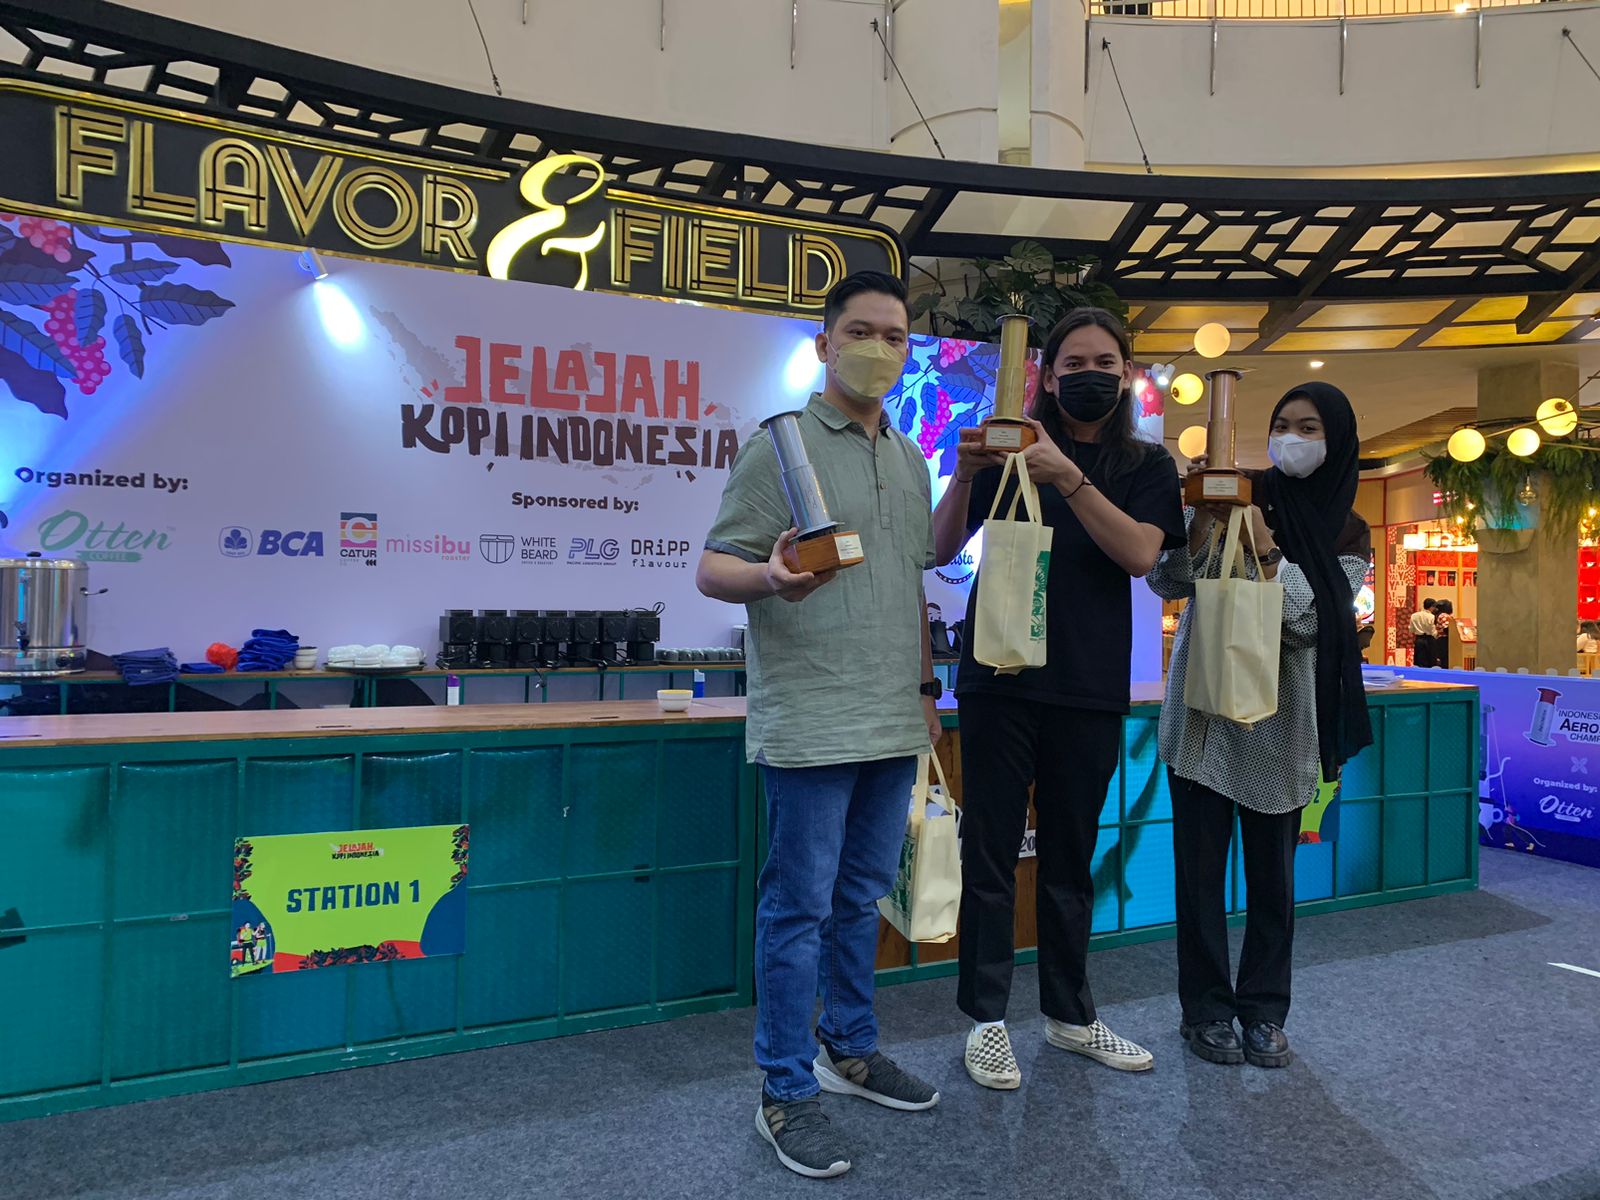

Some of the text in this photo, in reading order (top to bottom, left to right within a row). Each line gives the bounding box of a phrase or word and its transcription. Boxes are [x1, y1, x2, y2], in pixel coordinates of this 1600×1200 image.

[55, 105, 847, 308] FLAVOR & FIELD
[444, 335, 700, 420] JELAJAH
[401, 404, 739, 470] KOPI INDONESIA
[15, 467, 189, 493] Organized by:
[512, 492, 639, 513] Sponsored by:
[38, 509, 172, 551] Otten
[257, 529, 324, 557] BCA
[340, 549, 377, 558] CATUR
[386, 534, 471, 554] missibu
[521, 536, 557, 548] WHITE
[568, 538, 620, 560] PLG
[631, 539, 690, 556] DRiPP
[521, 548, 558, 560] BEARD
[632, 559, 688, 569] flavour
[1539, 795, 1594, 819] Otten
[286, 879, 420, 913] STATION 1
